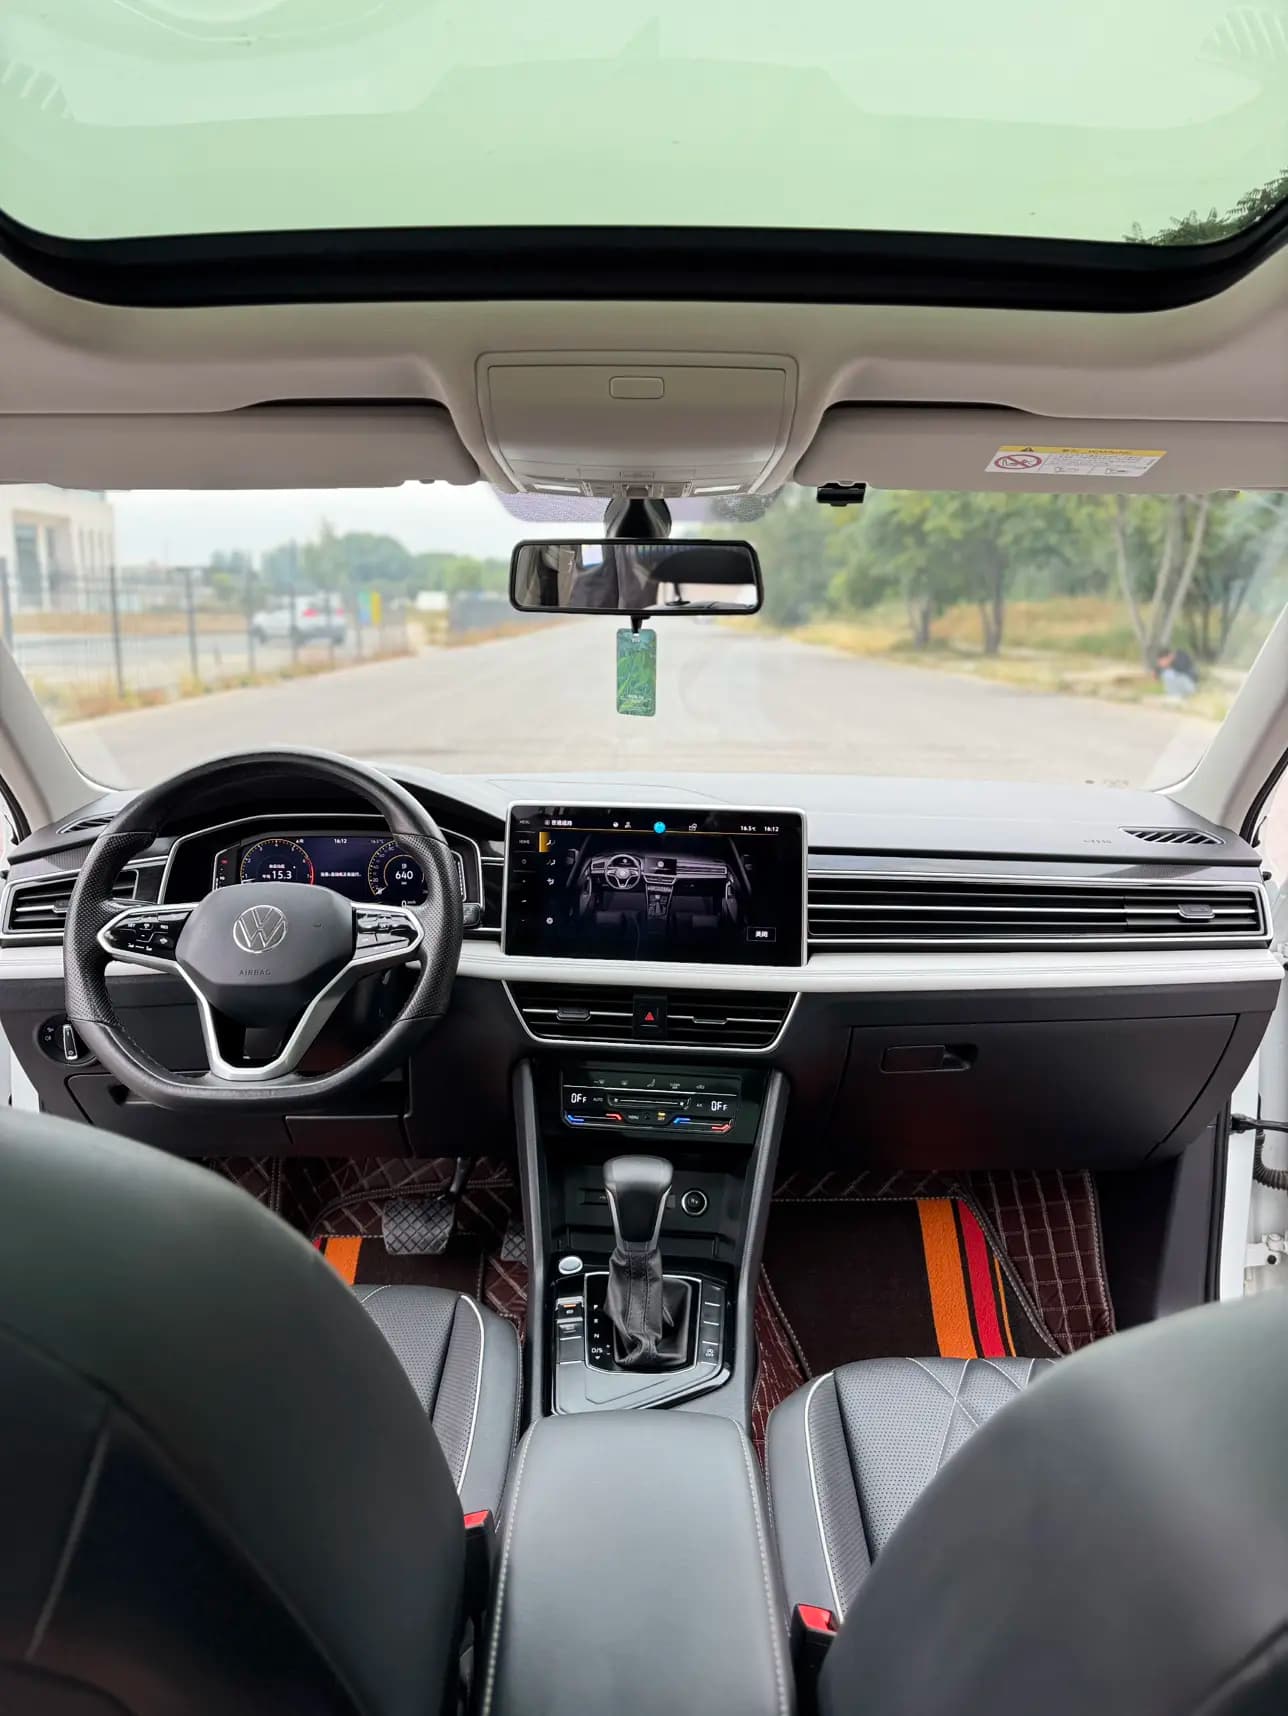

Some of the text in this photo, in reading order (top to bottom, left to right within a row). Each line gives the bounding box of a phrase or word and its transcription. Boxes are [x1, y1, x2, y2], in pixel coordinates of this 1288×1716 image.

[272, 870, 292, 879] 15.3
[395, 870, 414, 880] 640
[239, 968, 272, 976] AIRBAG
